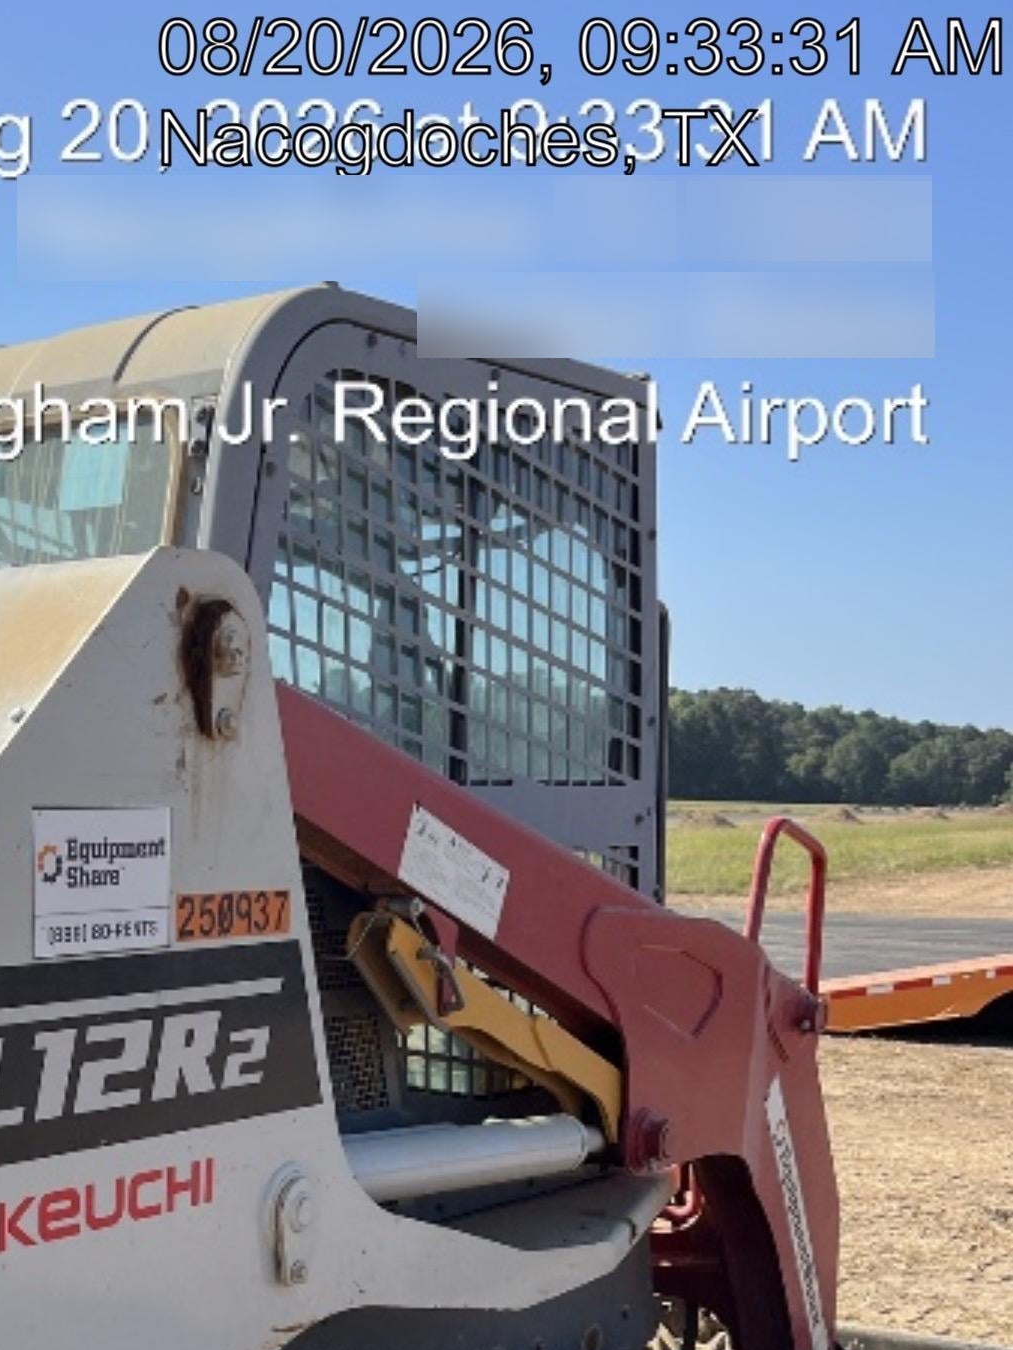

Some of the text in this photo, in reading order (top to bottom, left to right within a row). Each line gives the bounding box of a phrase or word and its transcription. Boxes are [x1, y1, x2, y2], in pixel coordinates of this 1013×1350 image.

[66, 836, 166, 864] Equipment
[66, 866, 120, 889] Share
[178, 891, 289, 938] 250937
